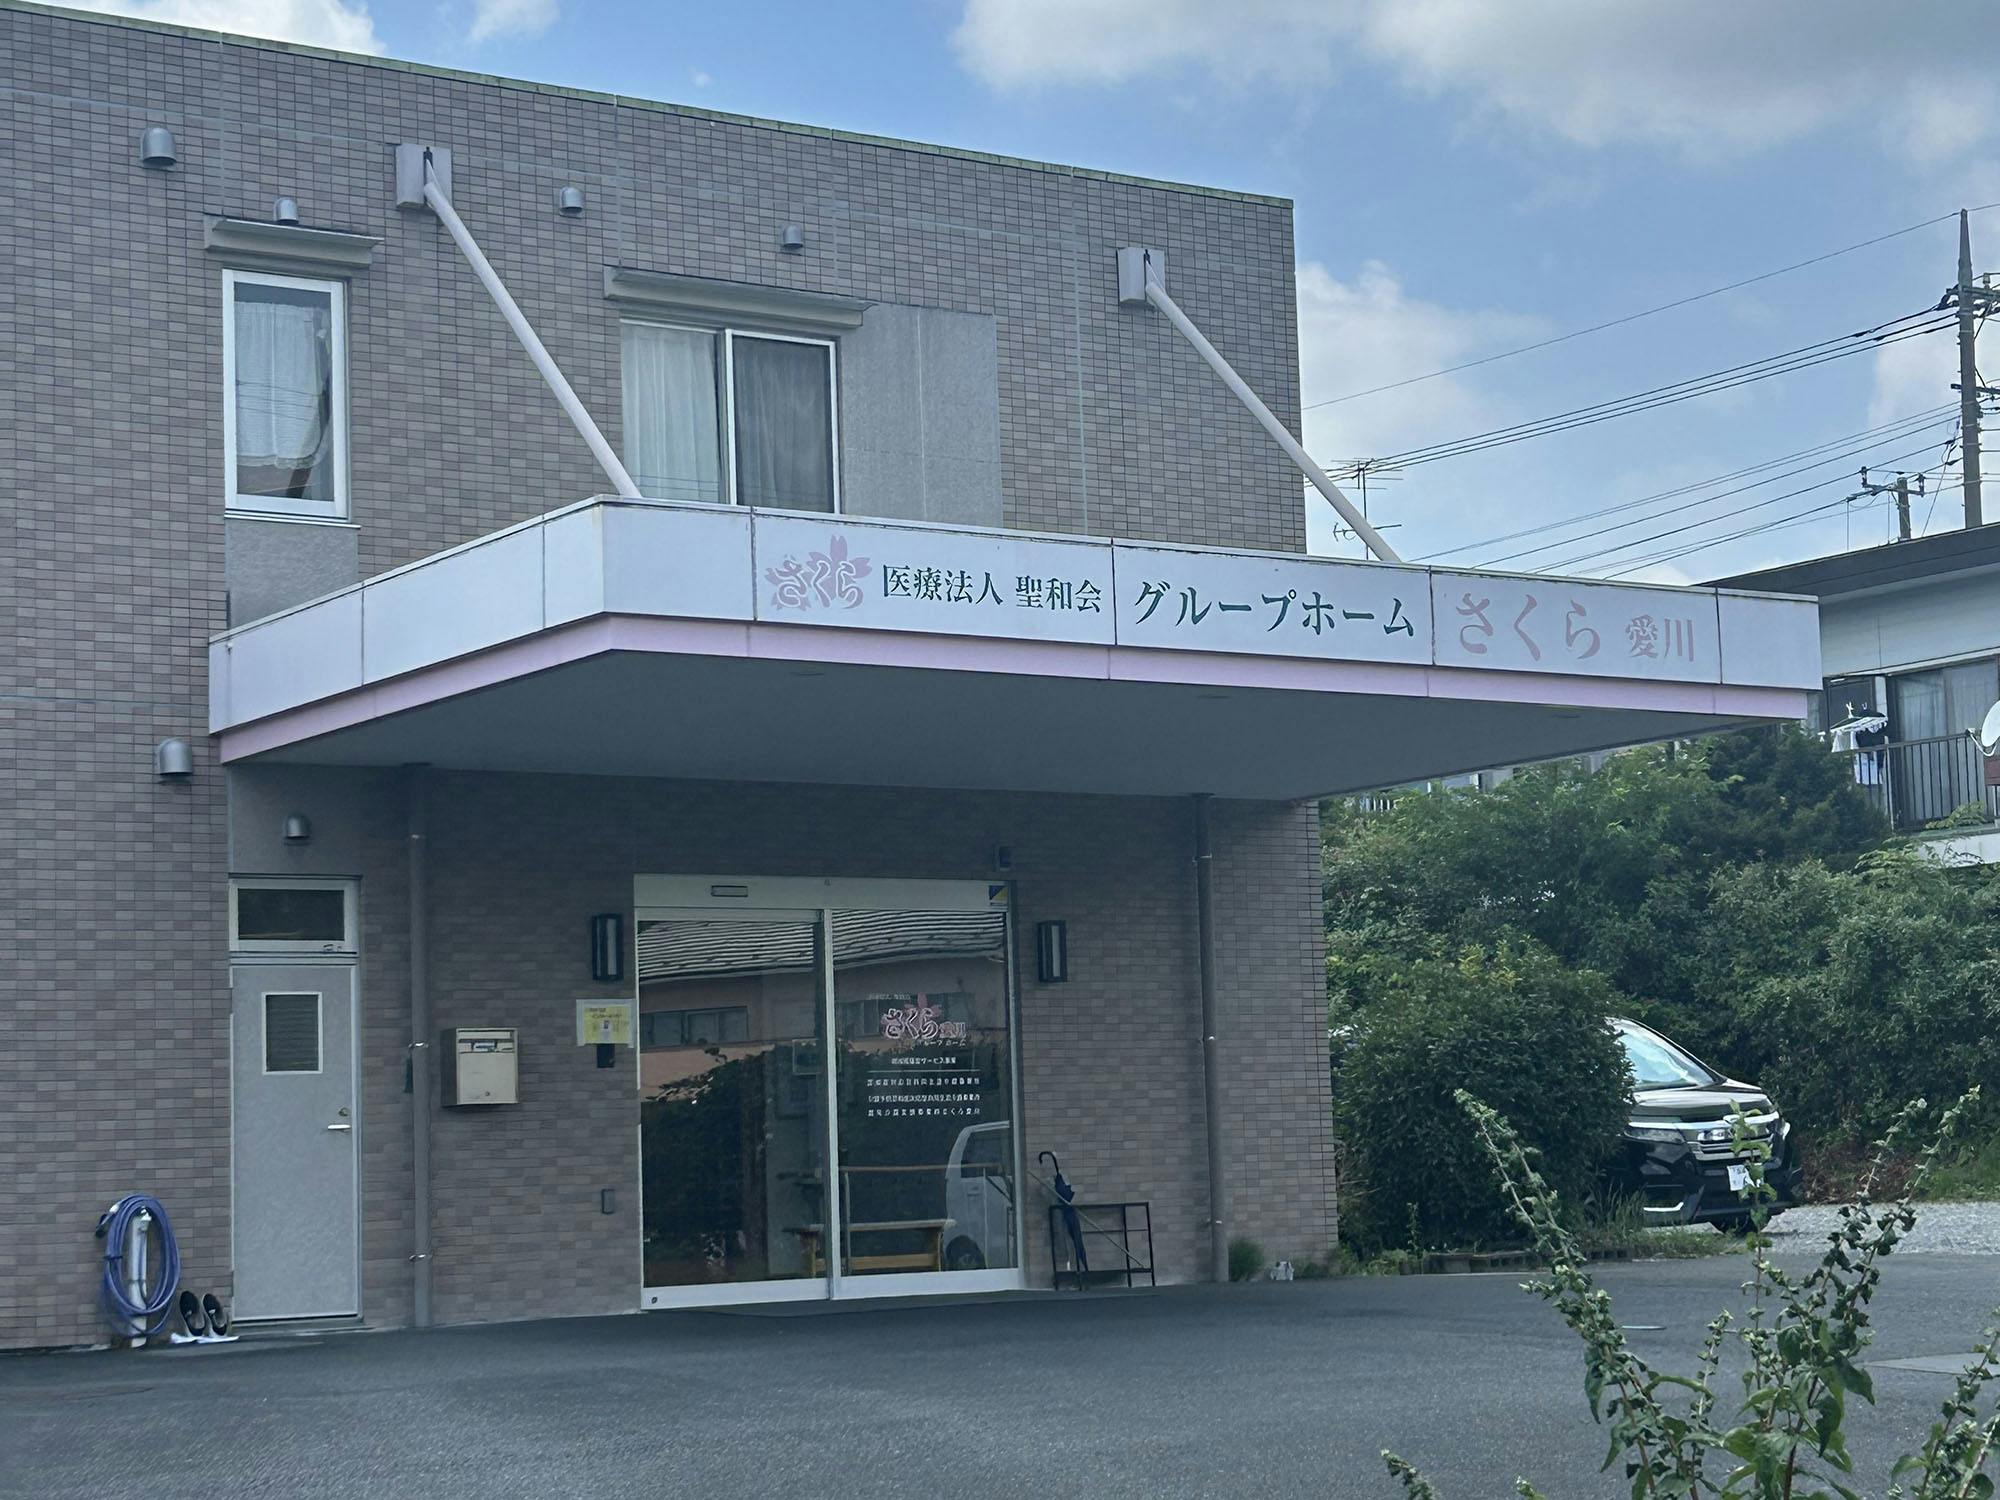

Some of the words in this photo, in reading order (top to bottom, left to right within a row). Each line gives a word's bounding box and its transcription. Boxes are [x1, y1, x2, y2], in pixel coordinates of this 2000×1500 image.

[774, 557, 864, 609] さくら
[882, 563, 1003, 606] 医療法人
[1015, 574, 1102, 613] 聖和会
[1133, 579, 1415, 638] グループホーム
[1454, 591, 1602, 661] さくら
[1625, 614, 1695, 662] 愛川
